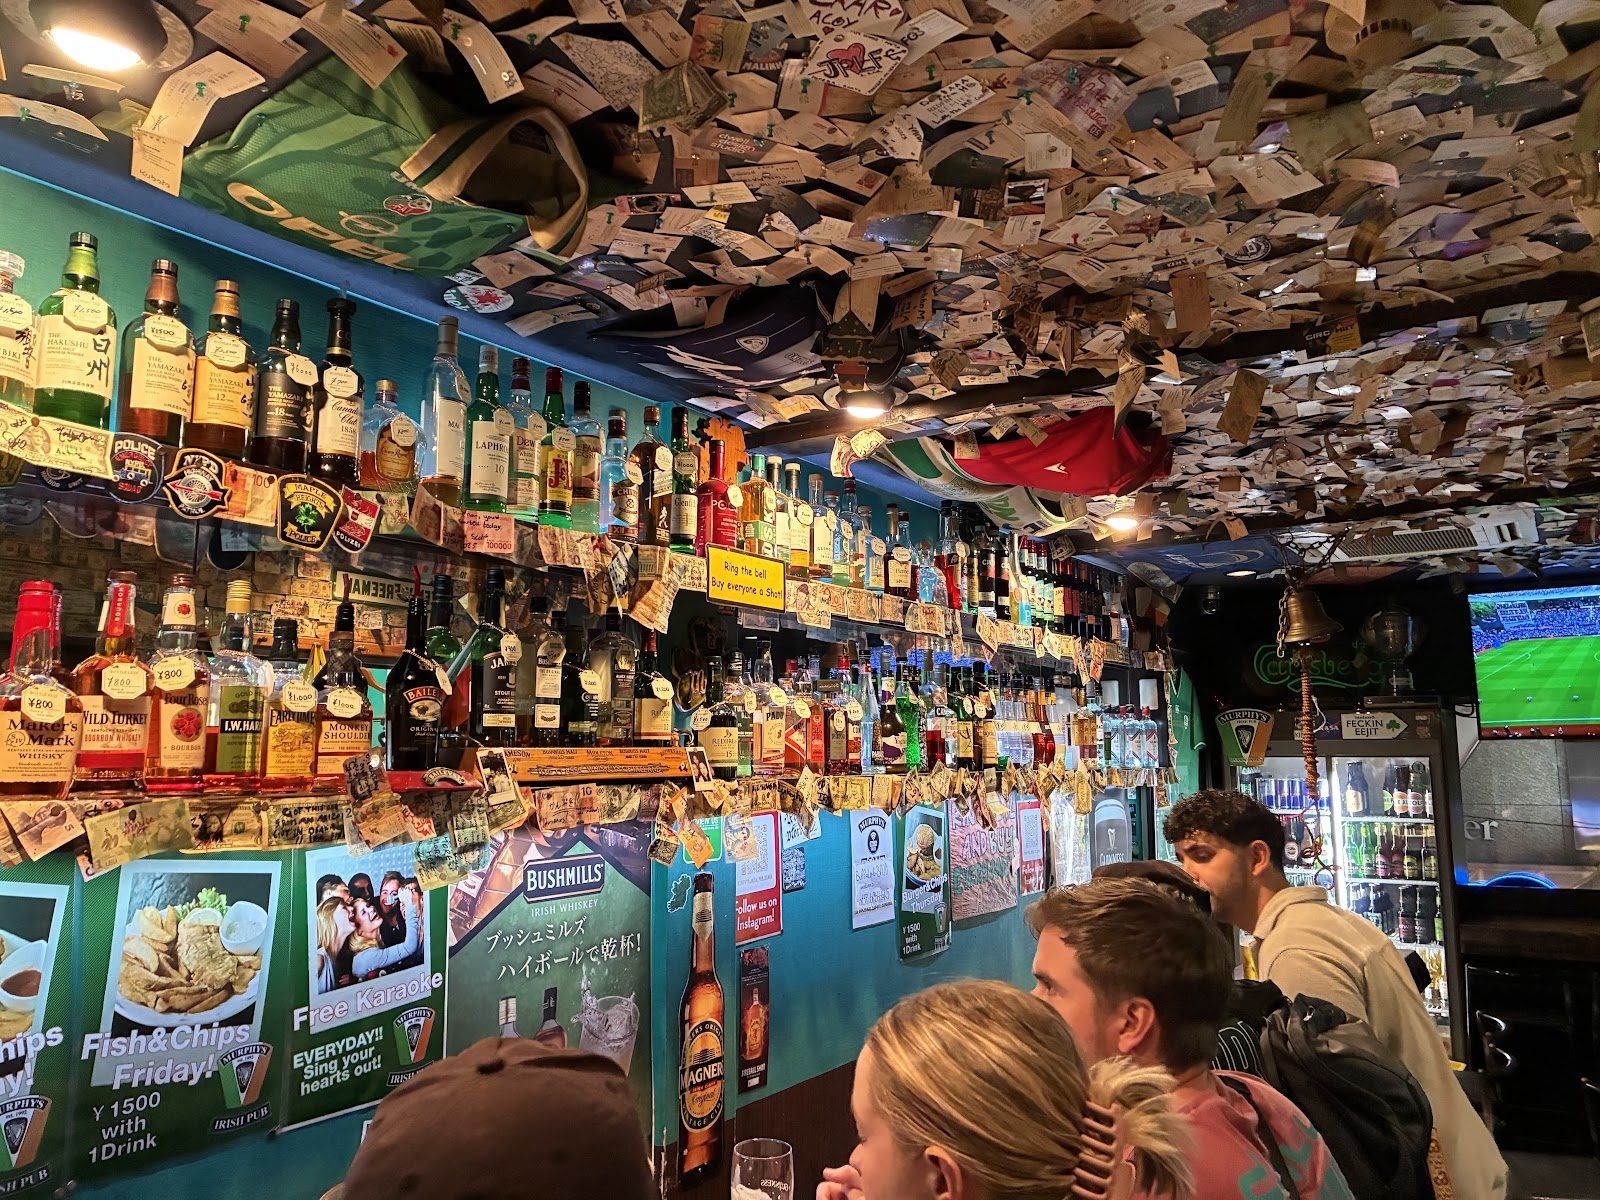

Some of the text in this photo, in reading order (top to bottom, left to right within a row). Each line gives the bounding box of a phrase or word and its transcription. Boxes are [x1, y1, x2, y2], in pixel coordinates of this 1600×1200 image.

[710, 142, 746, 154] studio
[227, 182, 414, 272] OPEL
[47, 340, 89, 350] HAKUSHU
[1, 348, 21, 359] BIKI
[147, 362, 185, 375] YAMAZAKI
[209, 377, 244, 388] YAMAZAKI
[215, 393, 227, 401] 12
[274, 407, 286, 416] 18
[115, 439, 156, 461] POLICE
[183, 454, 220, 475] NYPD
[495, 463, 505, 474] 10
[294, 483, 327, 499] MAPLE
[178, 503, 206, 515] PATROL
[295, 493, 326, 510] HEIGHTS
[288, 529, 317, 543] POLICE
[336, 530, 362, 549] POLIZEI
[486, 541, 512, 550] 100000
[724, 561, 767, 580] Ring the bell
[711, 576, 783, 600] Buy everyone a Shot!
[114, 587, 125, 622] BOURBON
[1254, 645, 1390, 688] Carsbeg
[107, 677, 131, 687] ¥800
[157, 669, 182, 680] ¥800
[164, 692, 188, 705] Four
[408, 689, 443, 700] BAILE
[28, 697, 53, 709] ¥800
[83, 710, 148, 726] WILD TURKEY
[1220, 711, 1268, 724] MURPHY'S
[1346, 719, 1383, 728] FECKIN
[8, 719, 78, 732] Maker's
[329, 722, 369, 732] MONKEY
[1355, 727, 1379, 738] EEJIT
[26, 735, 75, 746] Mark
[85, 733, 141, 742] BOURBON WHISKEY
[503, 750, 531, 758] AMESON
[581, 786, 593, 796] 10
[988, 825, 1016, 856] BUY
[527, 865, 603, 891] BUSHMILLS
[901, 873, 948, 904] Burger&Chips
[531, 898, 599, 918] IRISH WHISKEY
[759, 900, 768, 910] us
[768, 897, 777, 906] on
[737, 910, 775, 931] Instagram!
[907, 922, 921, 934] 1500
[486, 915, 588, 954] ブッシュミルズ
[905, 934, 918, 944] with
[902, 943, 922, 955] 1Drink
[497, 933, 641, 981] ハイボールで乾杯!
[293, 972, 443, 1032] Free Karaoke
[80, 1022, 250, 1061] Fish&Chips
[293, 1026, 384, 1069] EVERYDAY!!
[303, 1046, 376, 1080] Sing your
[112, 1053, 215, 1090] Friday!
[300, 1055, 382, 1097] hearts out!
[111, 1091, 161, 1118] 1500
[214, 1106, 269, 1130] IRISH PUB
[101, 1115, 146, 1141] with
[88, 1133, 157, 1163] 1Drink
[20, 1168, 48, 1189] PUB
